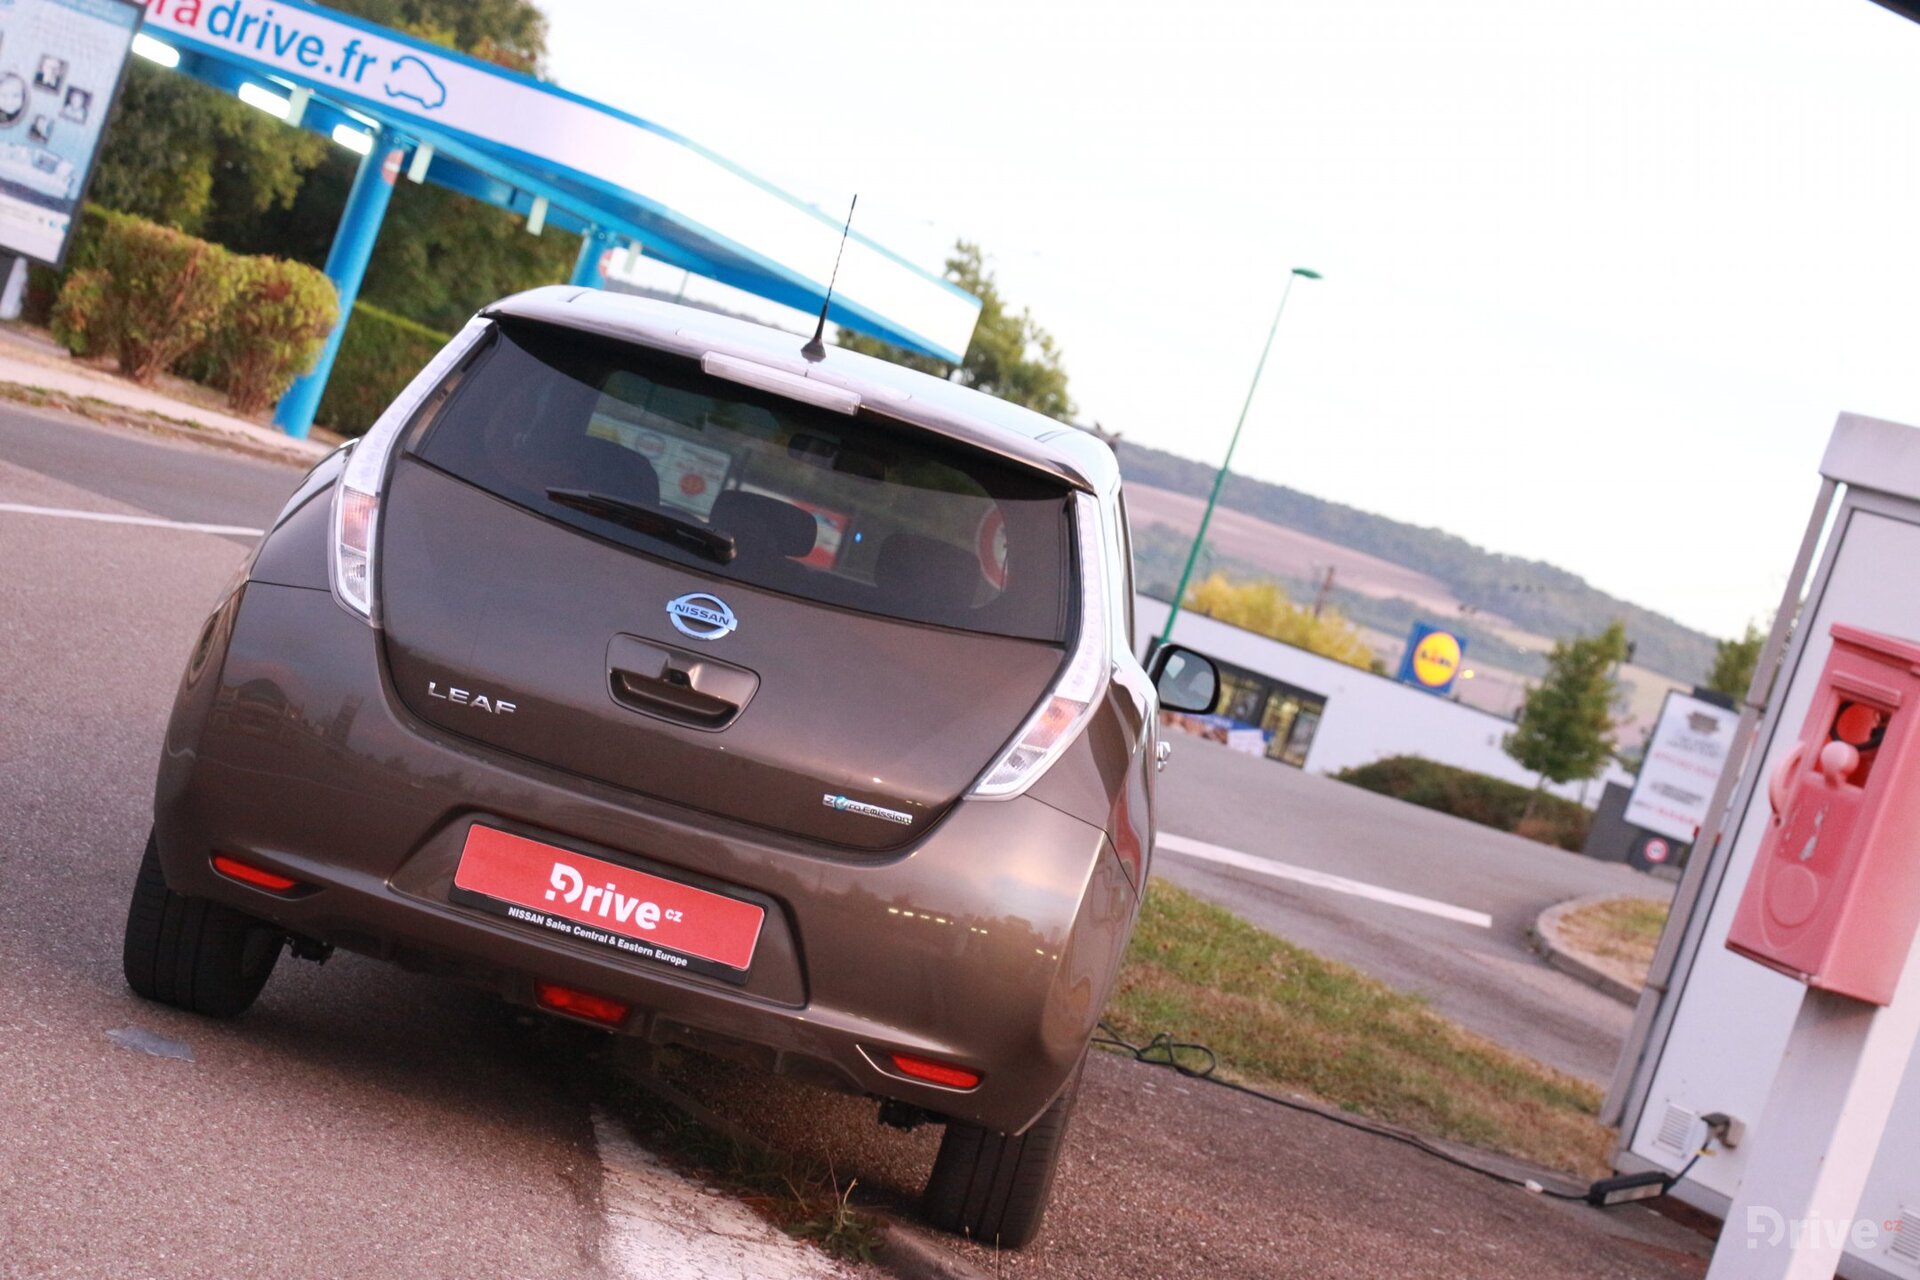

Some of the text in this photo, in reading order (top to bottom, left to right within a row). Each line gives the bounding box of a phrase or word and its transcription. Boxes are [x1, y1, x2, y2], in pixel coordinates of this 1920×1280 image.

[674, 603, 730, 626] NISSAN
[428, 681, 517, 715] LEAF
[546, 863, 660, 929] Drive
[508, 907, 688, 967] NISSAN Sales Central & Eastern Europe
